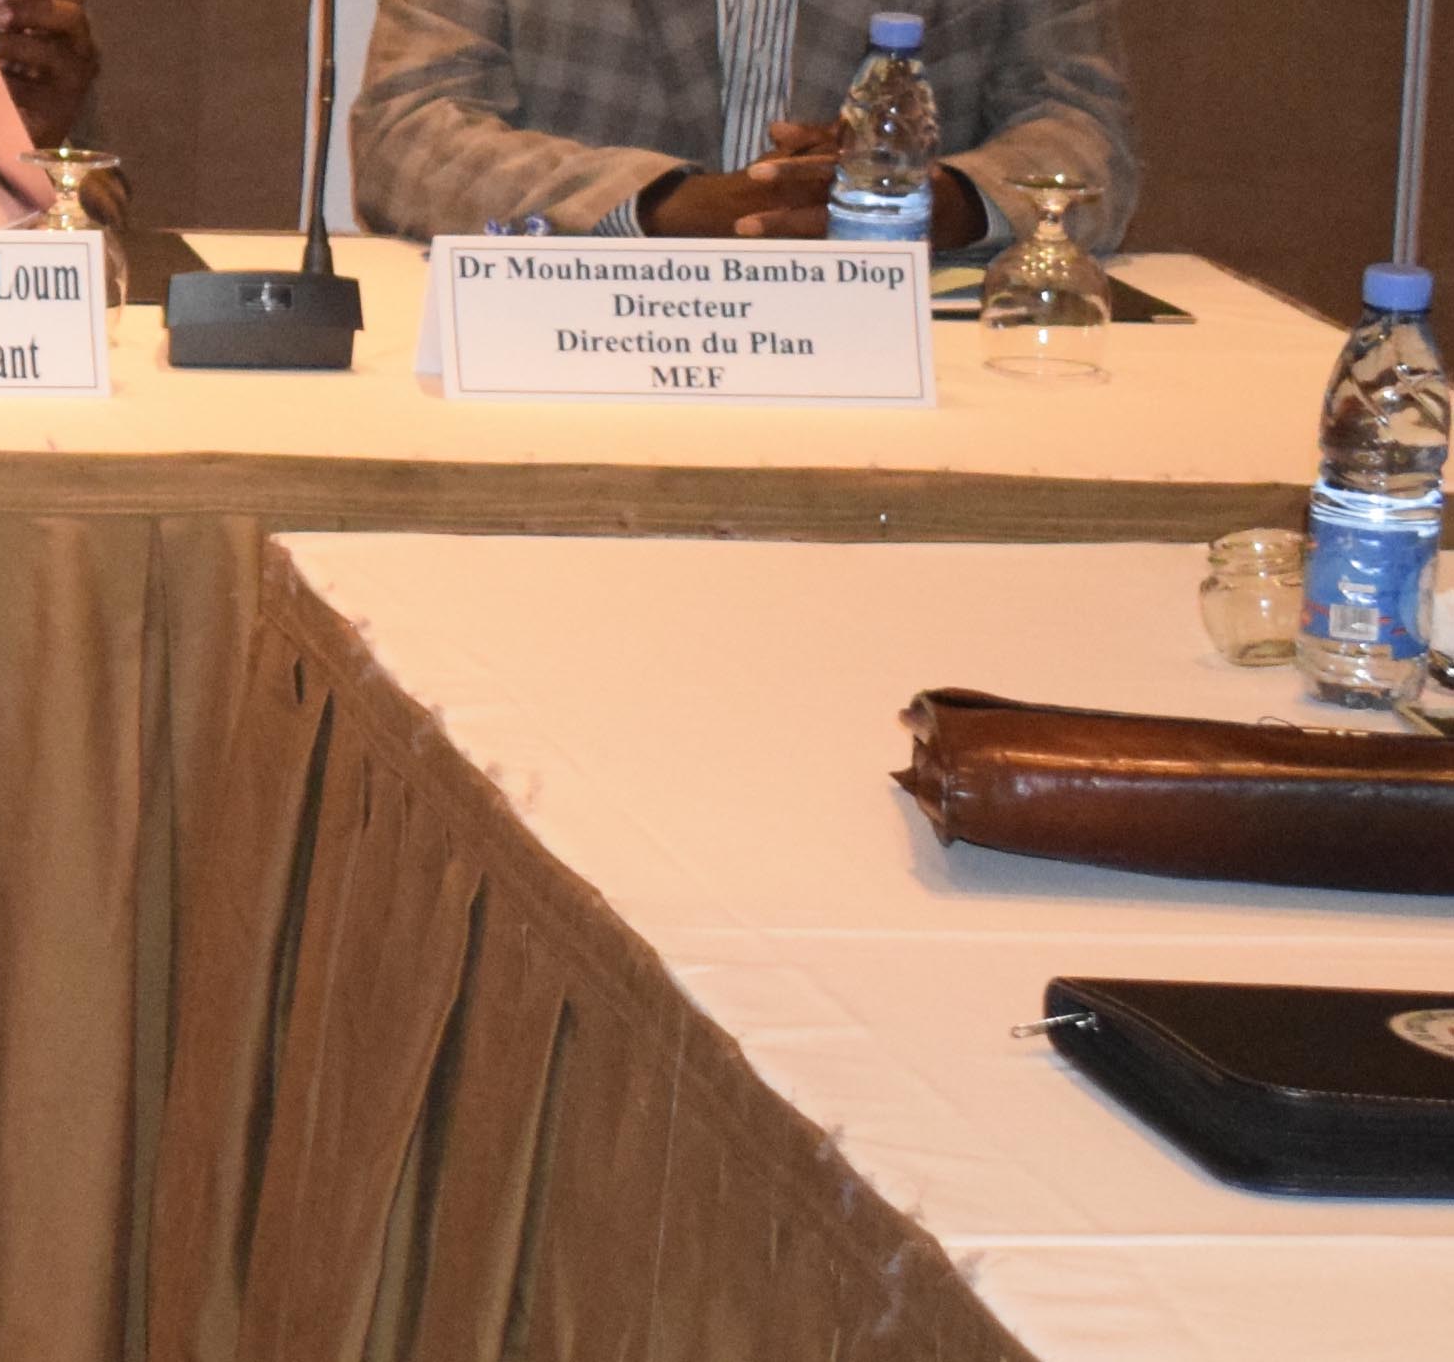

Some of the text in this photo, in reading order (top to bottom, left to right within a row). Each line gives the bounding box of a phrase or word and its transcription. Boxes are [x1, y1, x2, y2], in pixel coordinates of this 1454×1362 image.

[457, 254, 906, 292] Dr Mouhamadou Bamba Diop
[612, 293, 753, 320] Directeur
[556, 328, 815, 356] Direction du Plan
[651, 365, 724, 390] MEF
